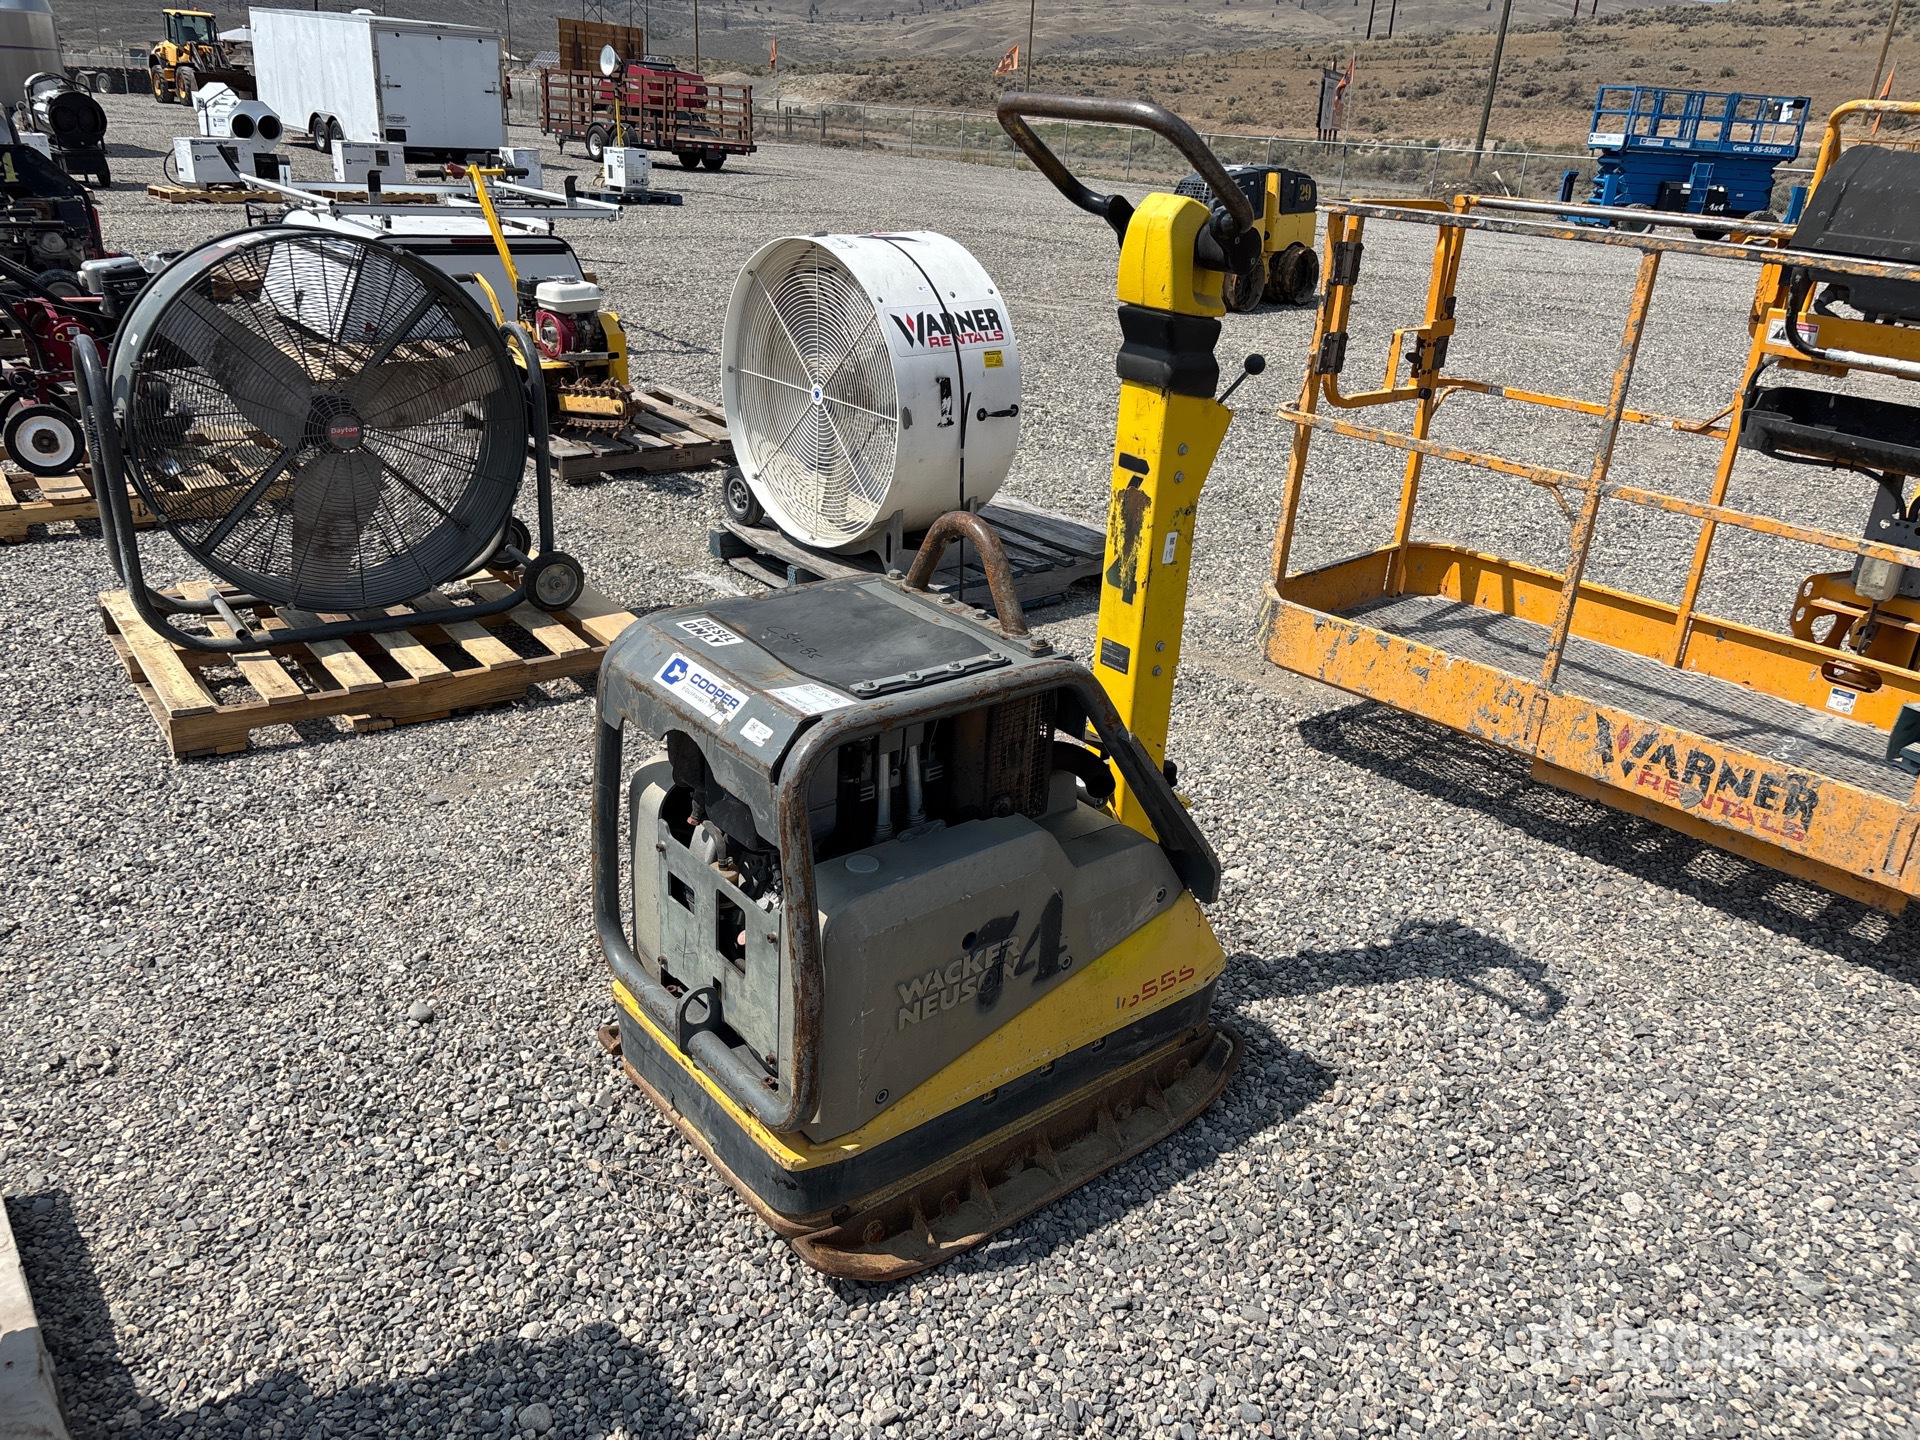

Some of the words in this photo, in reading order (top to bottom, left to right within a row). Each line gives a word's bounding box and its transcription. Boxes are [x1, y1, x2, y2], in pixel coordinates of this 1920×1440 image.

[1709, 202, 1725, 212] 4x4
[889, 308, 1004, 349] WARNER
[927, 330, 1005, 348] RENTALS
[330, 426, 358, 435] Dayton
[682, 622, 724, 644] ONLY
[696, 619, 737, 643] DIESEL
[689, 673, 740, 711] COOPER
[1595, 711, 1820, 834] WARNER
[897, 934, 1022, 1005] WACKER
